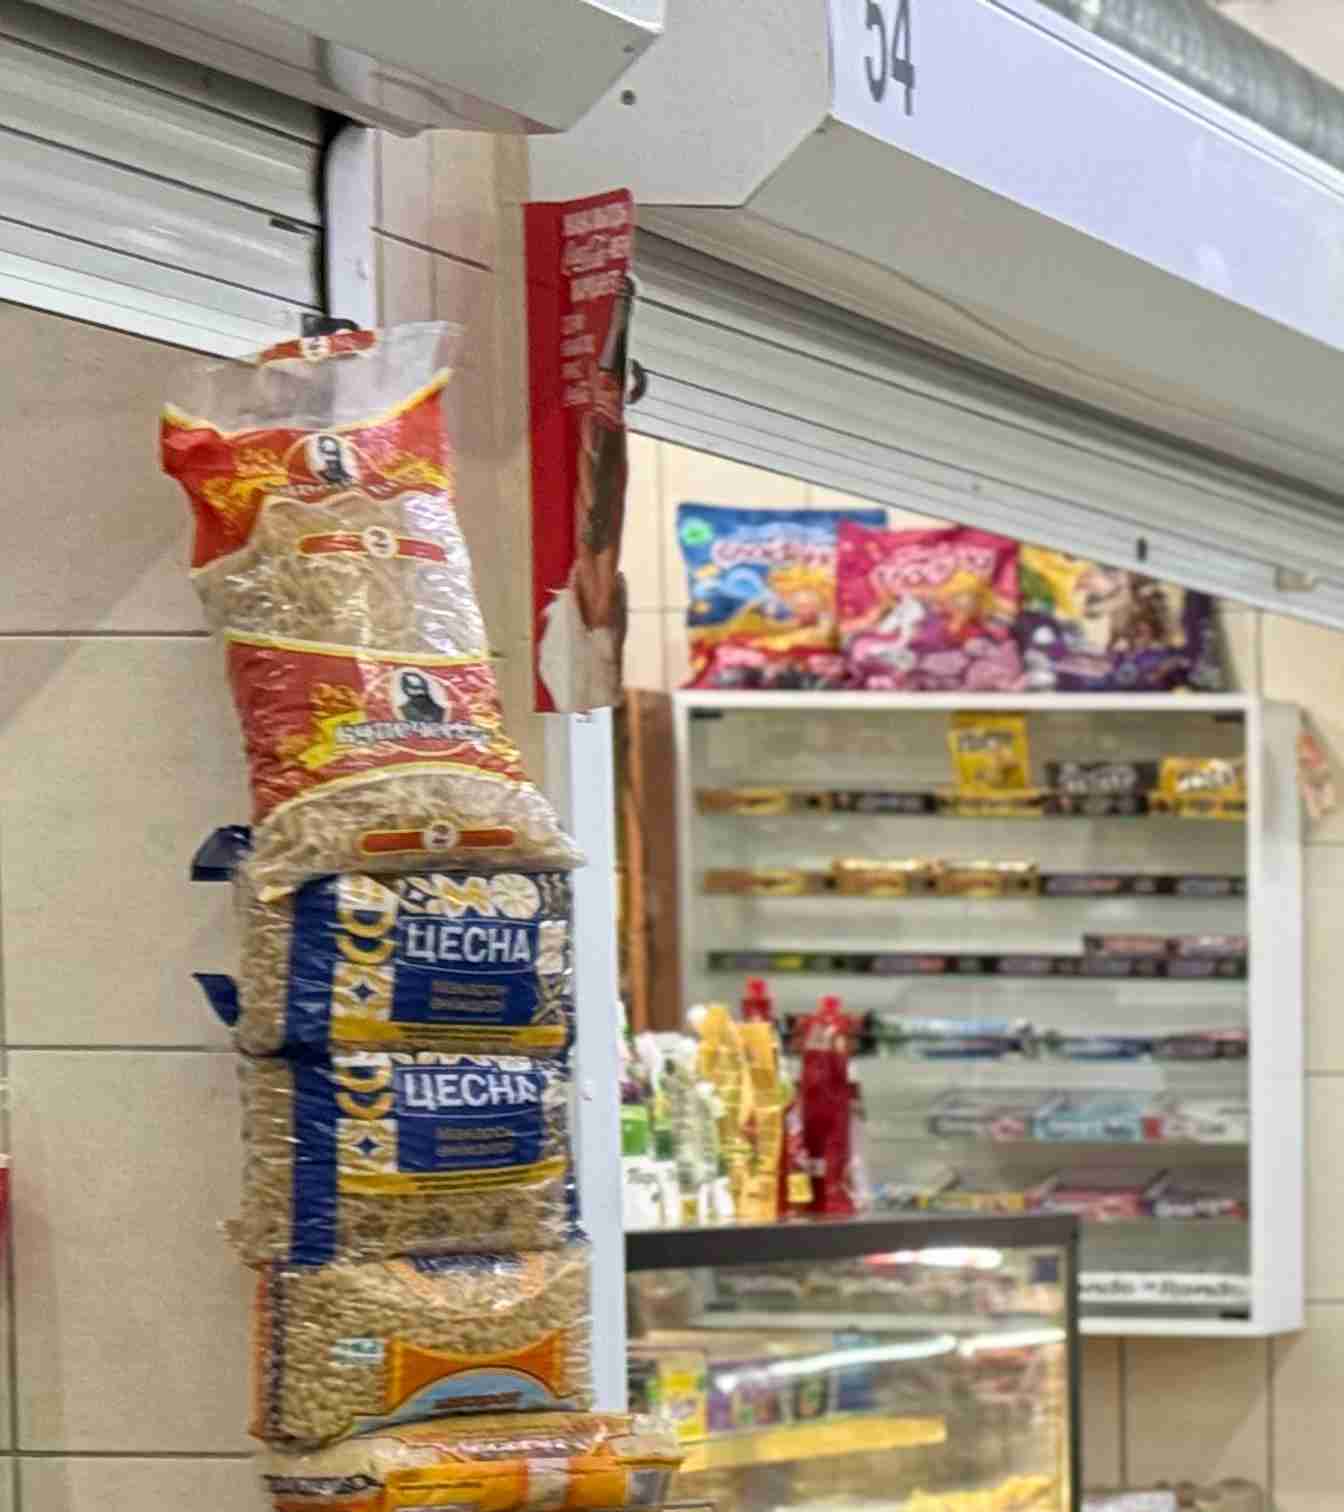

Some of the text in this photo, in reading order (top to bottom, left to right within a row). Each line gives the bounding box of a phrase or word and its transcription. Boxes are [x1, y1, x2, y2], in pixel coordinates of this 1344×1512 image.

[863, 0, 916, 117] 54
[404, 922, 532, 963] ЦЕСНА
[403, 1072, 541, 1110] ЦЕСНА
